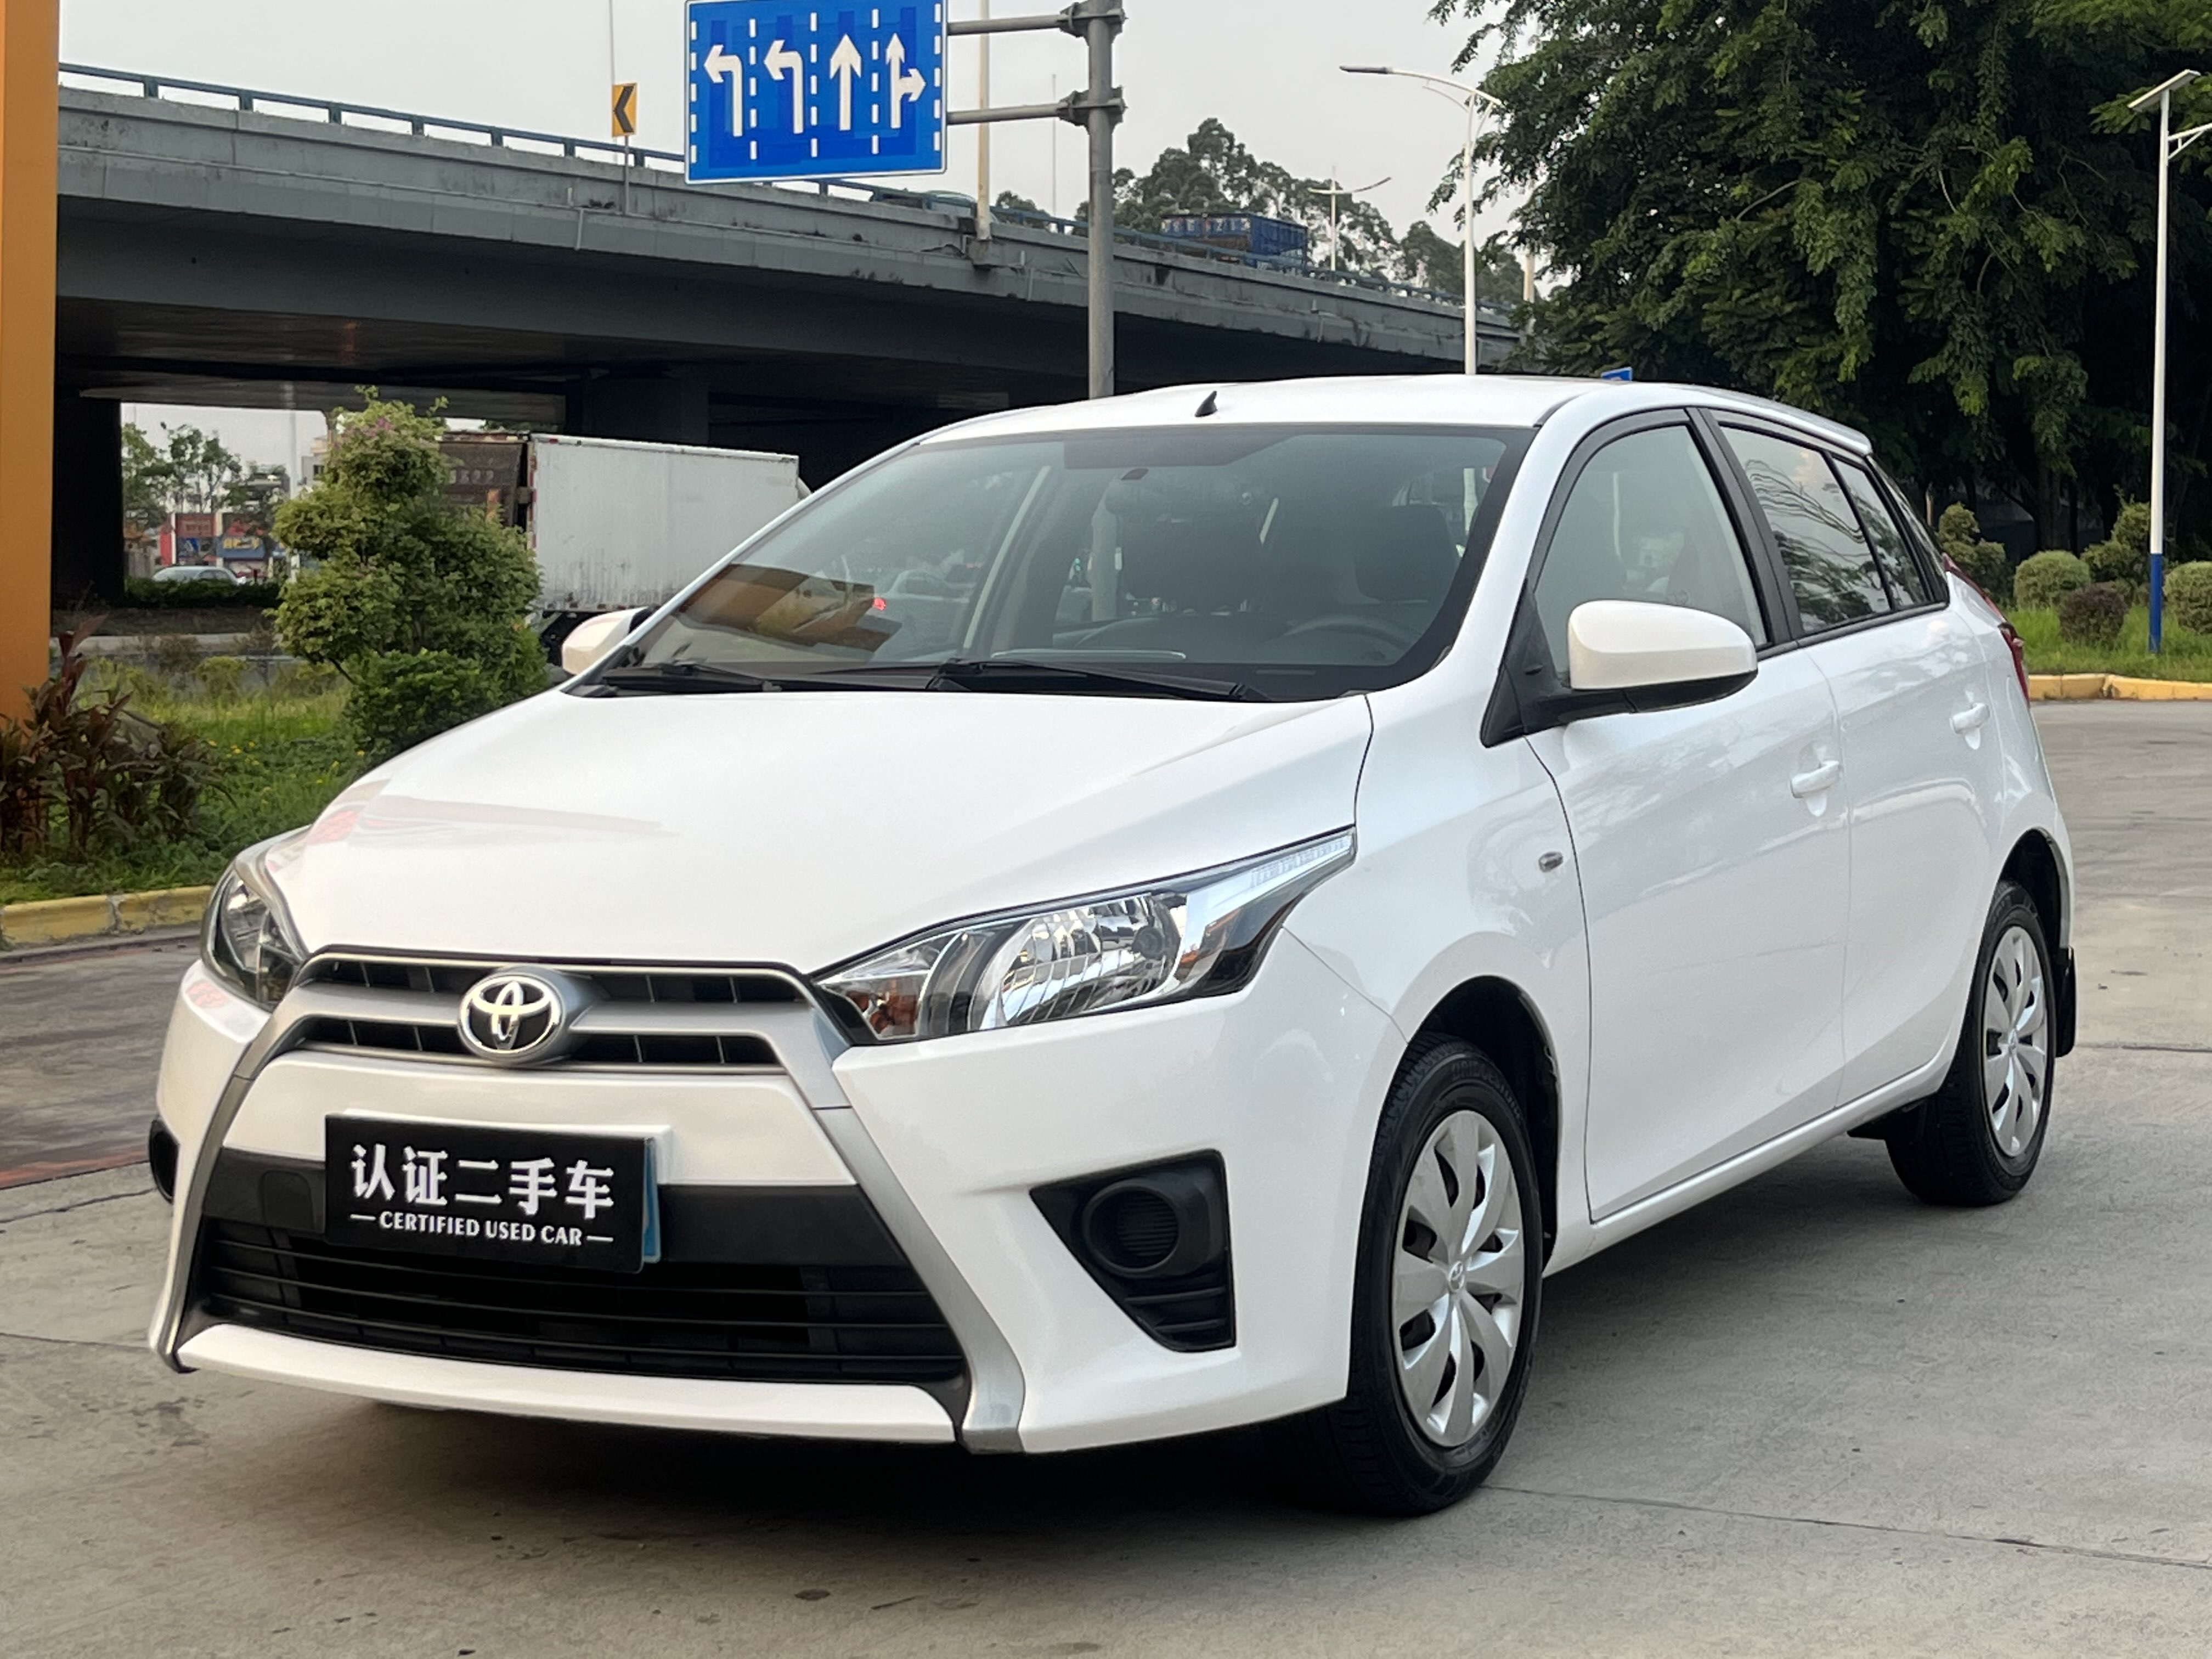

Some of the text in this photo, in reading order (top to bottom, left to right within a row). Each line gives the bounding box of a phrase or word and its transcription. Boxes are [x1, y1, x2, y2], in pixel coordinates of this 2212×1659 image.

[350, 1143, 614, 1220] 认证二手车
[379, 1210, 583, 1246] CERTIFIED USED CAR
